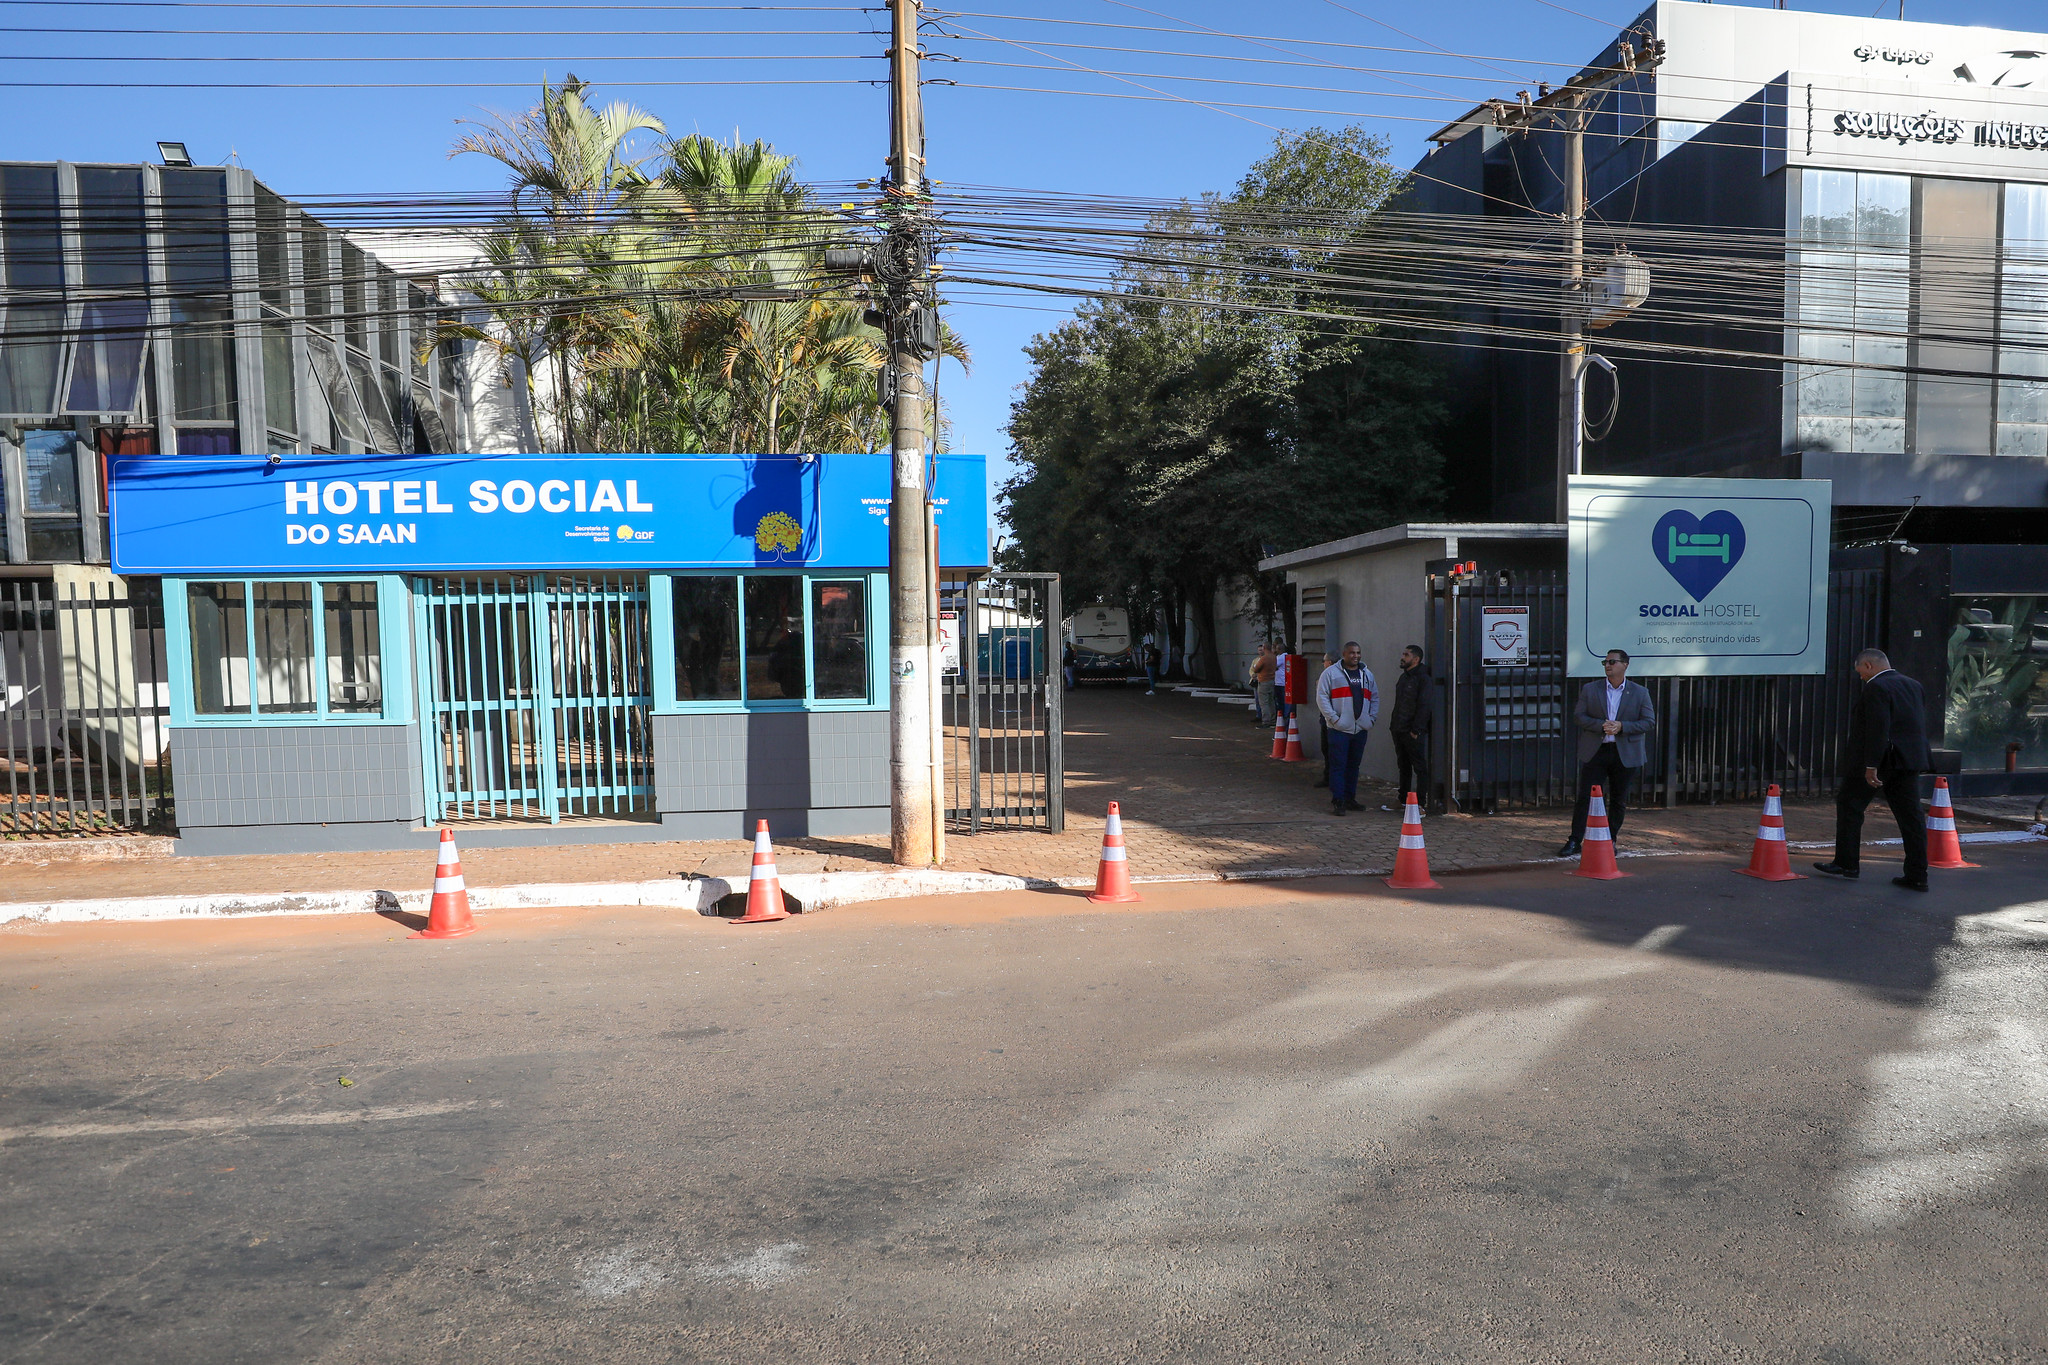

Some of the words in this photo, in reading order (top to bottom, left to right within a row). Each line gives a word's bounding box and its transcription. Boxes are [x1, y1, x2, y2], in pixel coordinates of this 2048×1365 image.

[1833, 109, 1968, 146] SOLUÇÕES
[285, 480, 453, 515] HOTEL
[468, 479, 653, 514] SOCIAL
[868, 506, 887, 516] Siga
[286, 523, 330, 545] DO
[337, 523, 416, 545] SAAN
[634, 531, 655, 540] GDF
[1639, 604, 1699, 617] SOCIAL
[1703, 604, 1761, 617] HOSTEL
[1637, 634, 1670, 645] juntos,
[1671, 634, 1736, 644] reconstruindo
[1737, 634, 1761, 643] vidas
